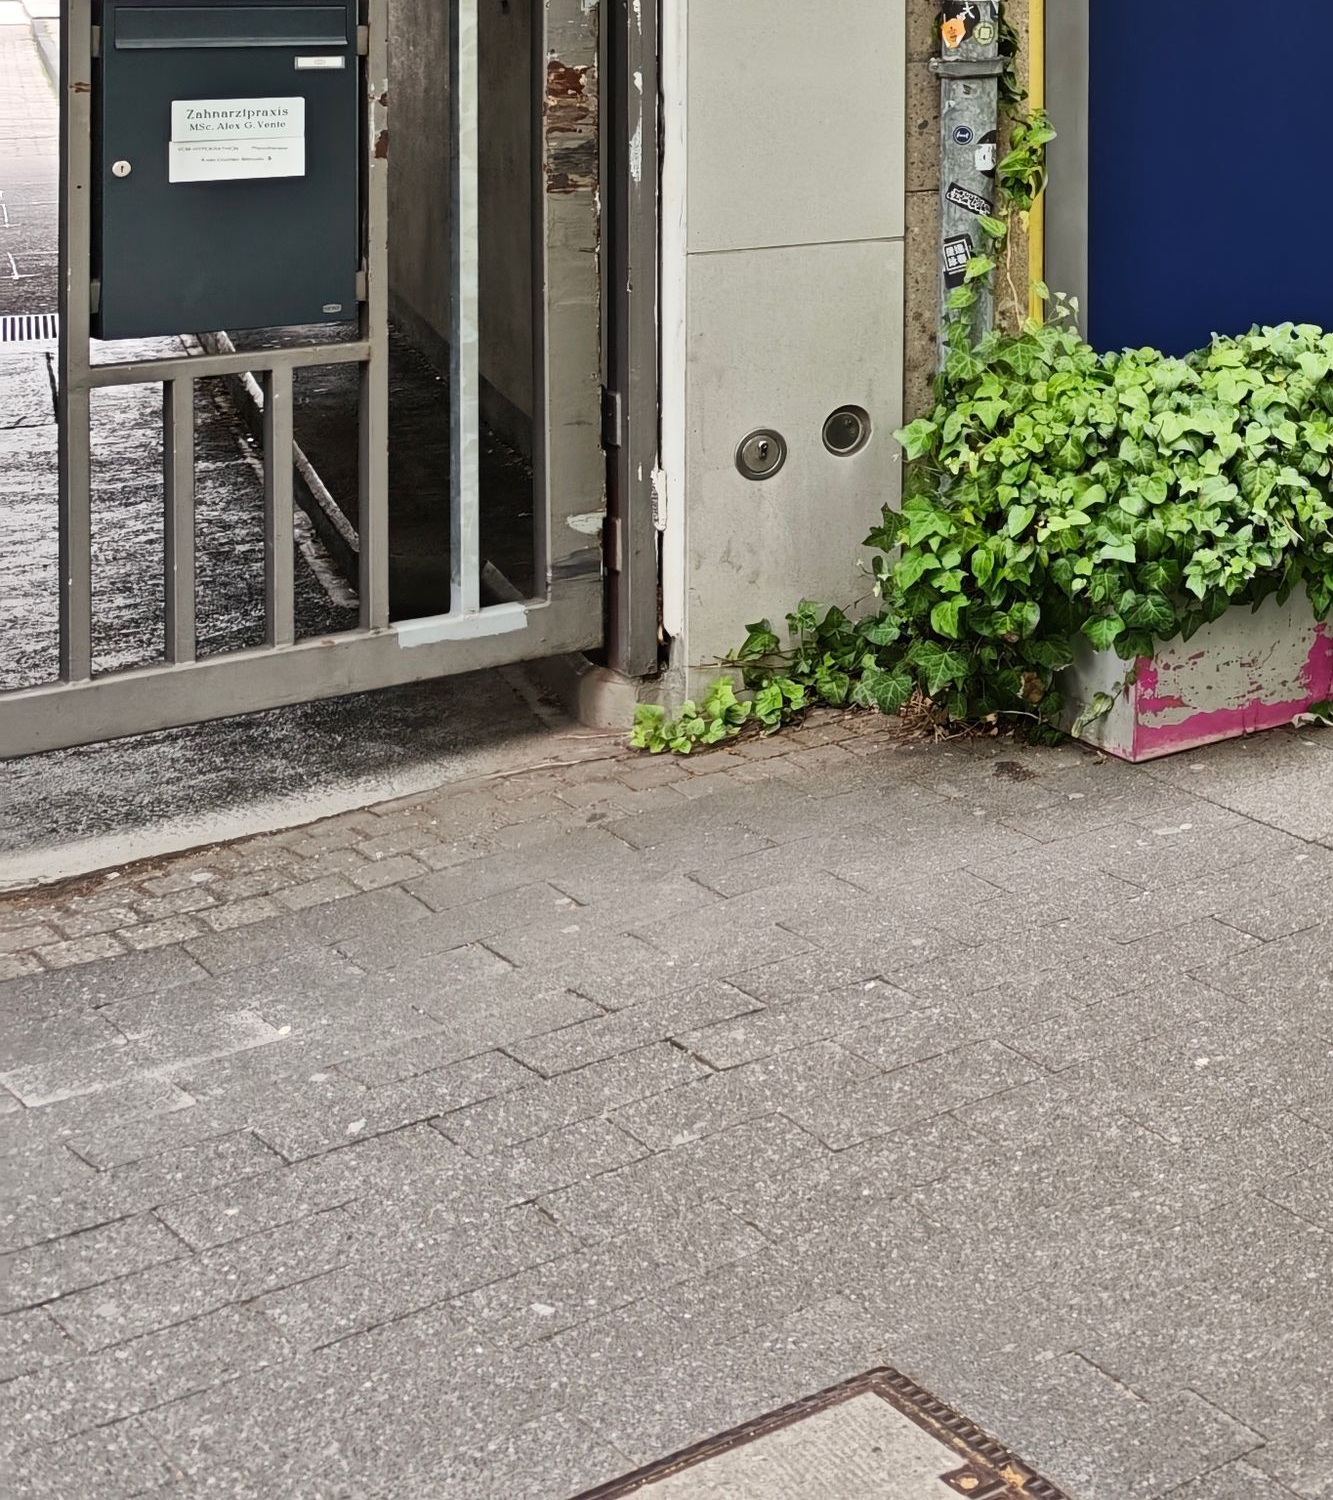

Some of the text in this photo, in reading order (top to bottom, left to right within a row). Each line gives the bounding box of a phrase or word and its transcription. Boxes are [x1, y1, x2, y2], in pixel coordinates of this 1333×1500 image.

[186, 107, 289, 120] Zahnarztpraxis
[189, 123, 215, 132] MSc.
[217, 122, 241, 131] Alex
